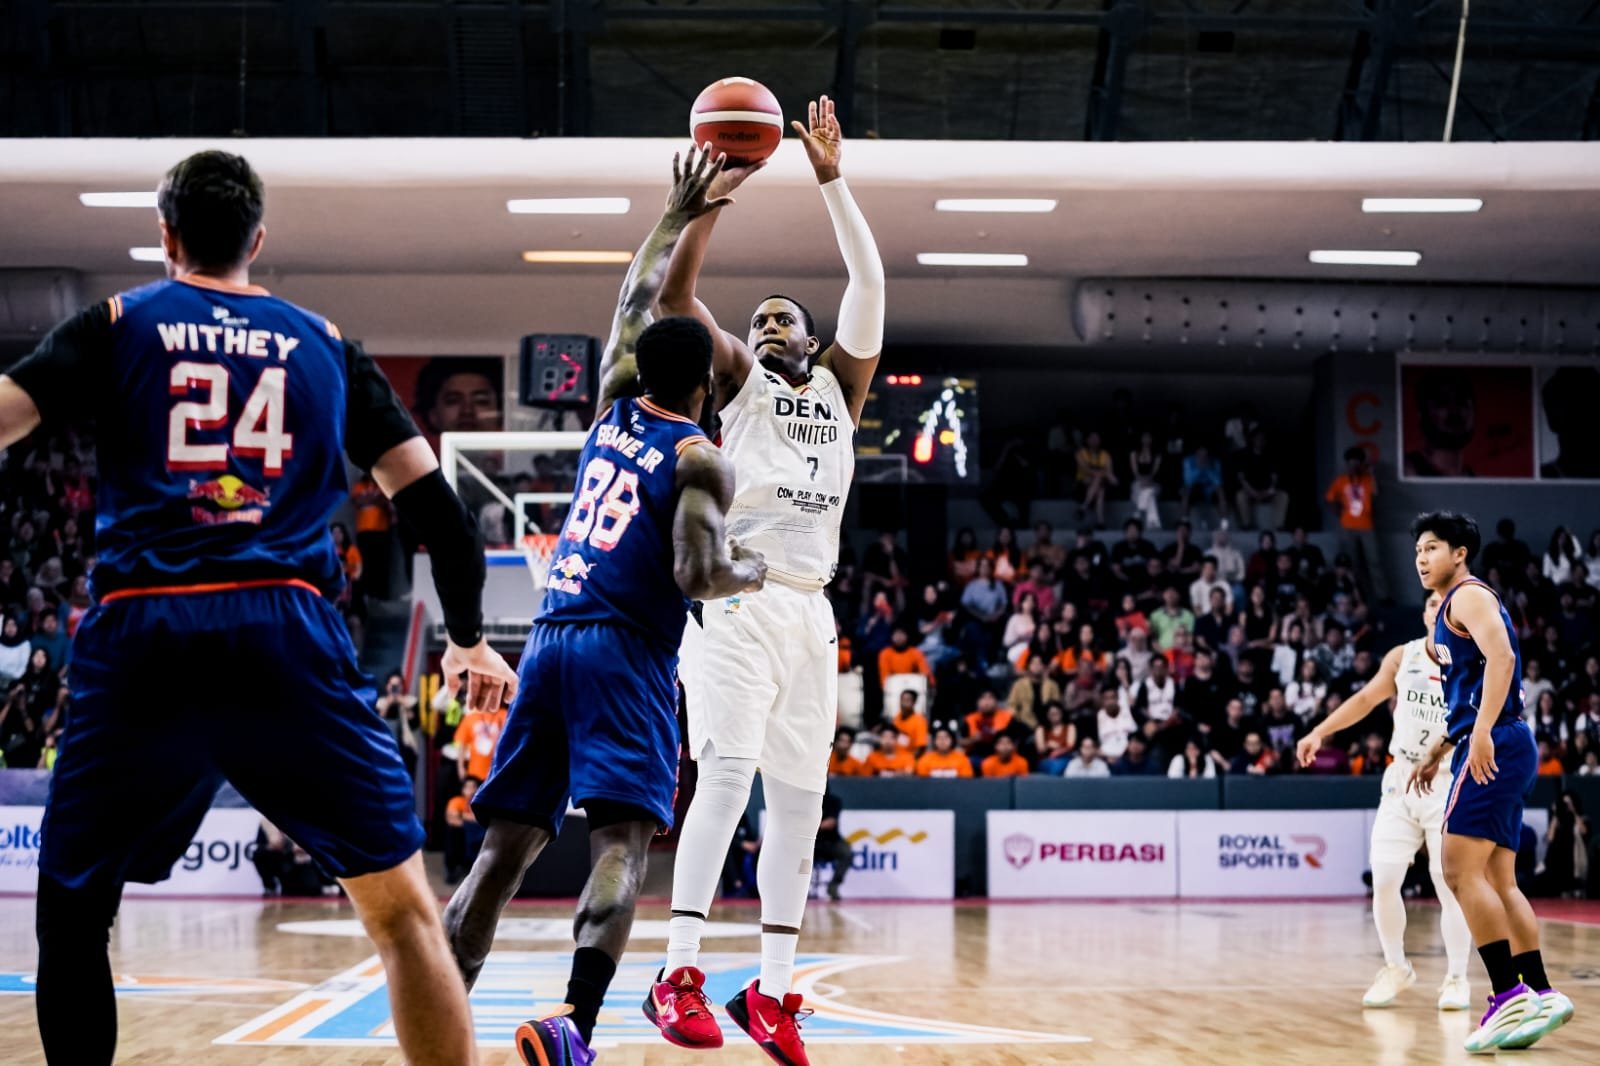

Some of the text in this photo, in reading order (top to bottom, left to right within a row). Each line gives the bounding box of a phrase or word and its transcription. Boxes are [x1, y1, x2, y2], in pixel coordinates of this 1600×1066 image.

[157, 322, 299, 360] WITHEY
[166, 361, 293, 477] 24
[787, 422, 837, 445] UNITED
[636, 446, 665, 474] JR
[806, 456, 819, 481] 7
[565, 457, 640, 552] 88
[1407, 690, 1444, 708] DEW
[1419, 729, 1430, 746] 2
[1040, 843, 1165, 862] PERBASI
[1219, 834, 1284, 849] ROYAL
[1219, 852, 1299, 869] SPORTS
